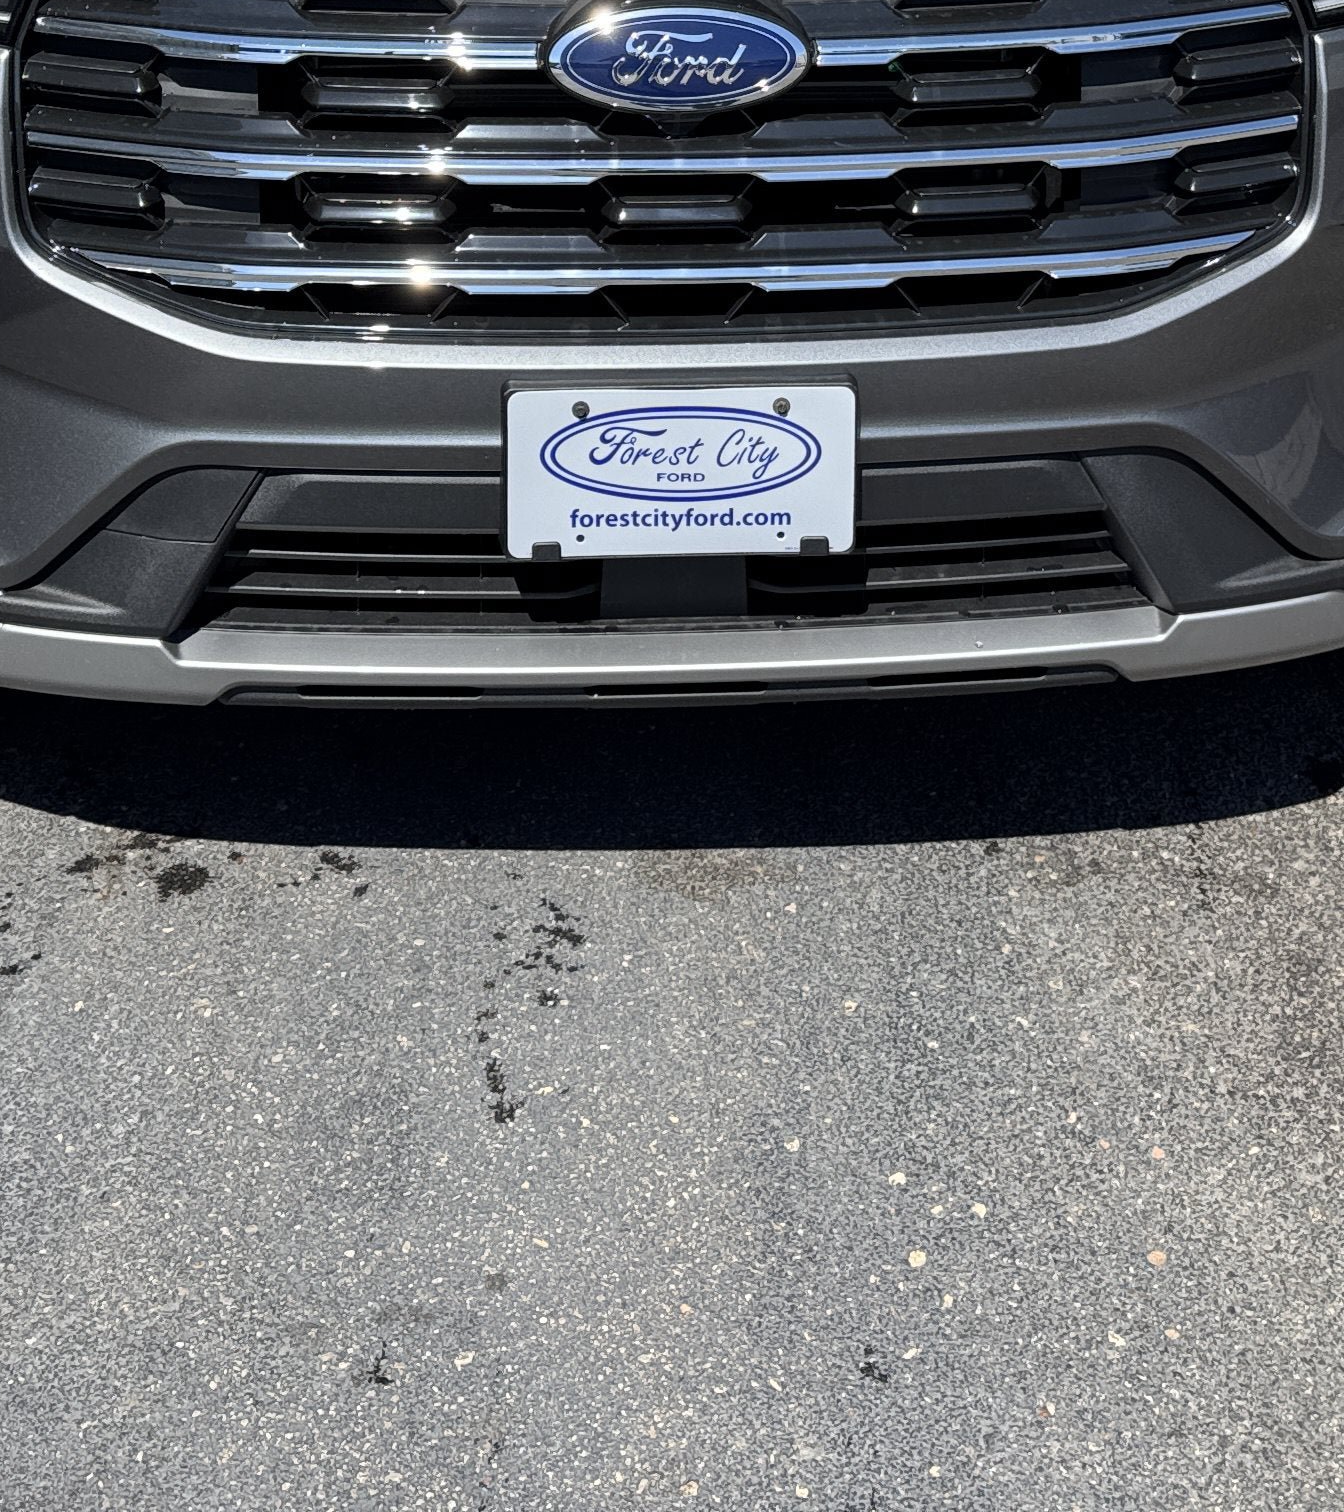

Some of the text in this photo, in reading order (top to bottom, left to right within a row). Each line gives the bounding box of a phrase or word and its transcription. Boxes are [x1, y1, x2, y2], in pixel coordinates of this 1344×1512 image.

[612, 30, 747, 86] Ford
[589, 427, 780, 479] Forest City
[656, 473, 706, 482] FORD
[570, 508, 792, 531] forestcityford.com
